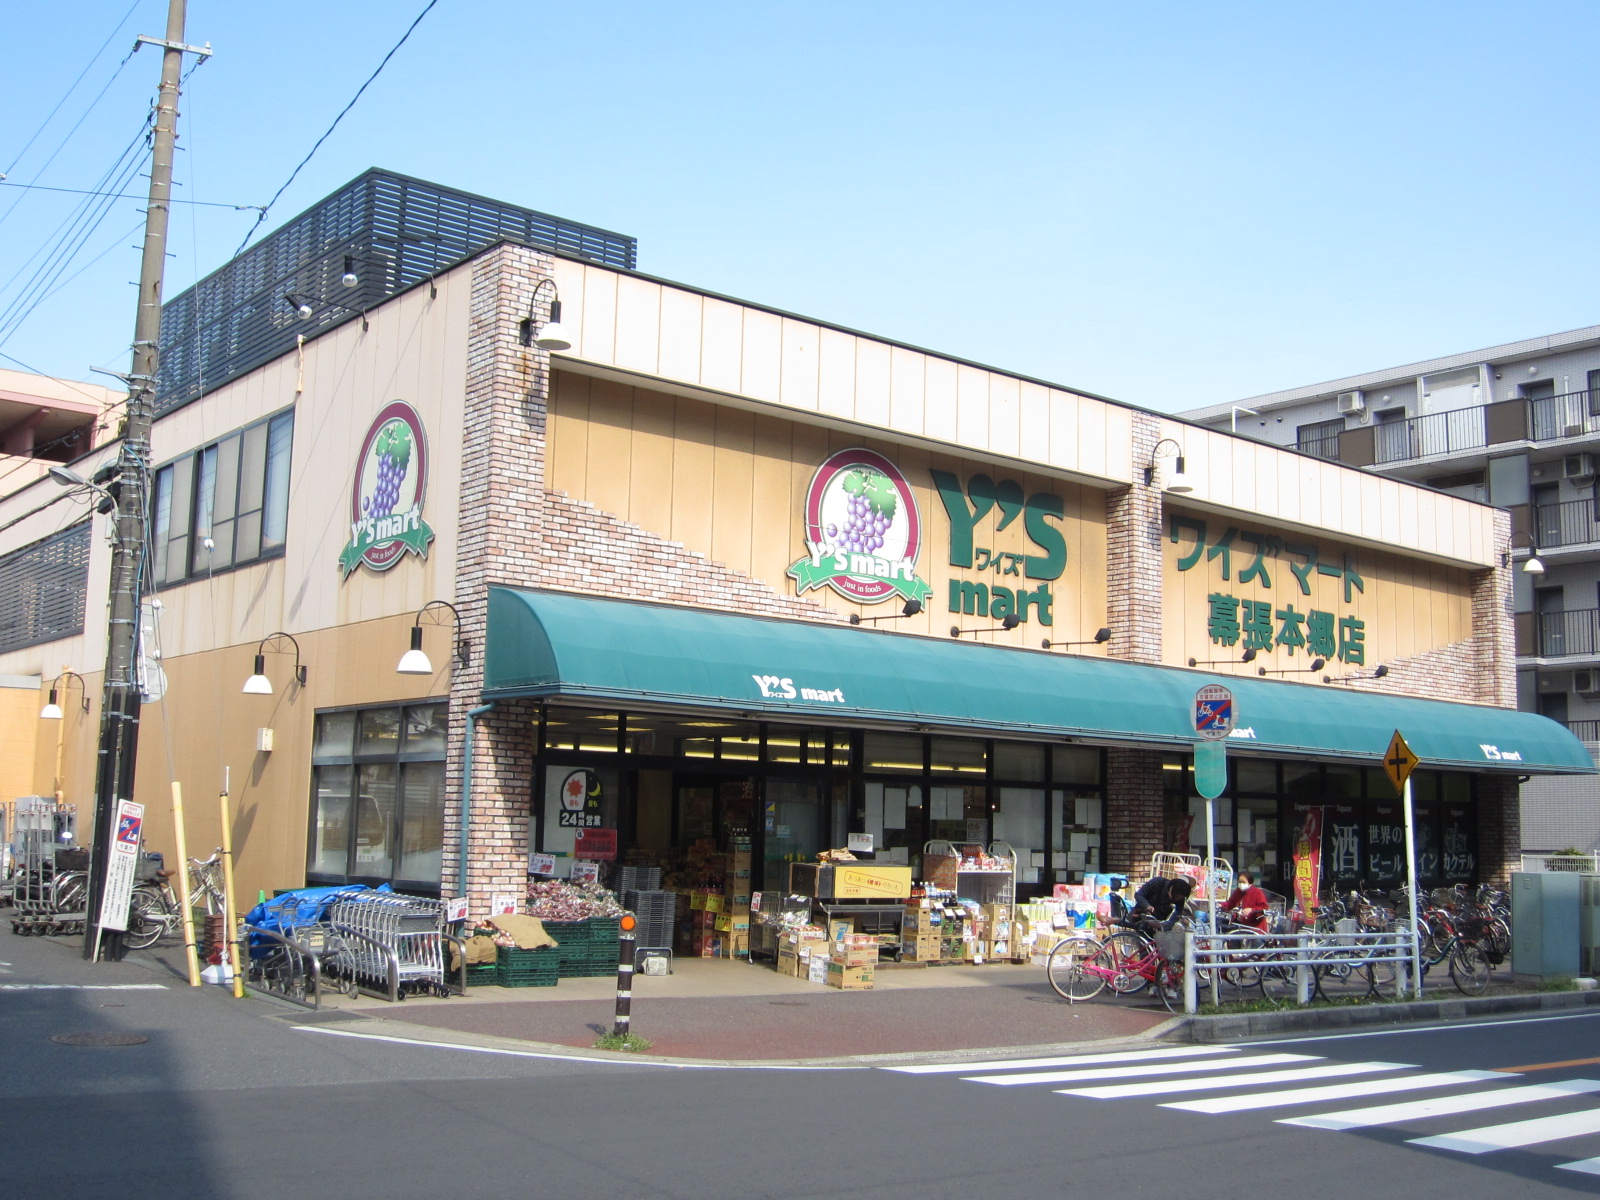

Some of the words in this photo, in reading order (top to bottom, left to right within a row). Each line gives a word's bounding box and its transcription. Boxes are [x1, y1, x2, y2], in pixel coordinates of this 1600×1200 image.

[376, 504, 419, 541] mart
[851, 553, 914, 581] mart
[976, 547, 1024, 576] ワイズ
[1170, 514, 1364, 603] ワイズマート
[842, 579, 856, 590] just
[858, 584, 864, 592] in
[865, 585, 882, 593] foods
[949, 578, 1053, 626] mart
[1207, 592, 1365, 666] 幕張本郷店
[800, 687, 845, 702] mart
[1331, 824, 1359, 872] 酒
[1369, 825, 1402, 844] 世界の
[1369, 853, 1402, 872] ビール
[1418, 853, 1438, 870] イン
[1443, 853, 1475, 871] カクテル
